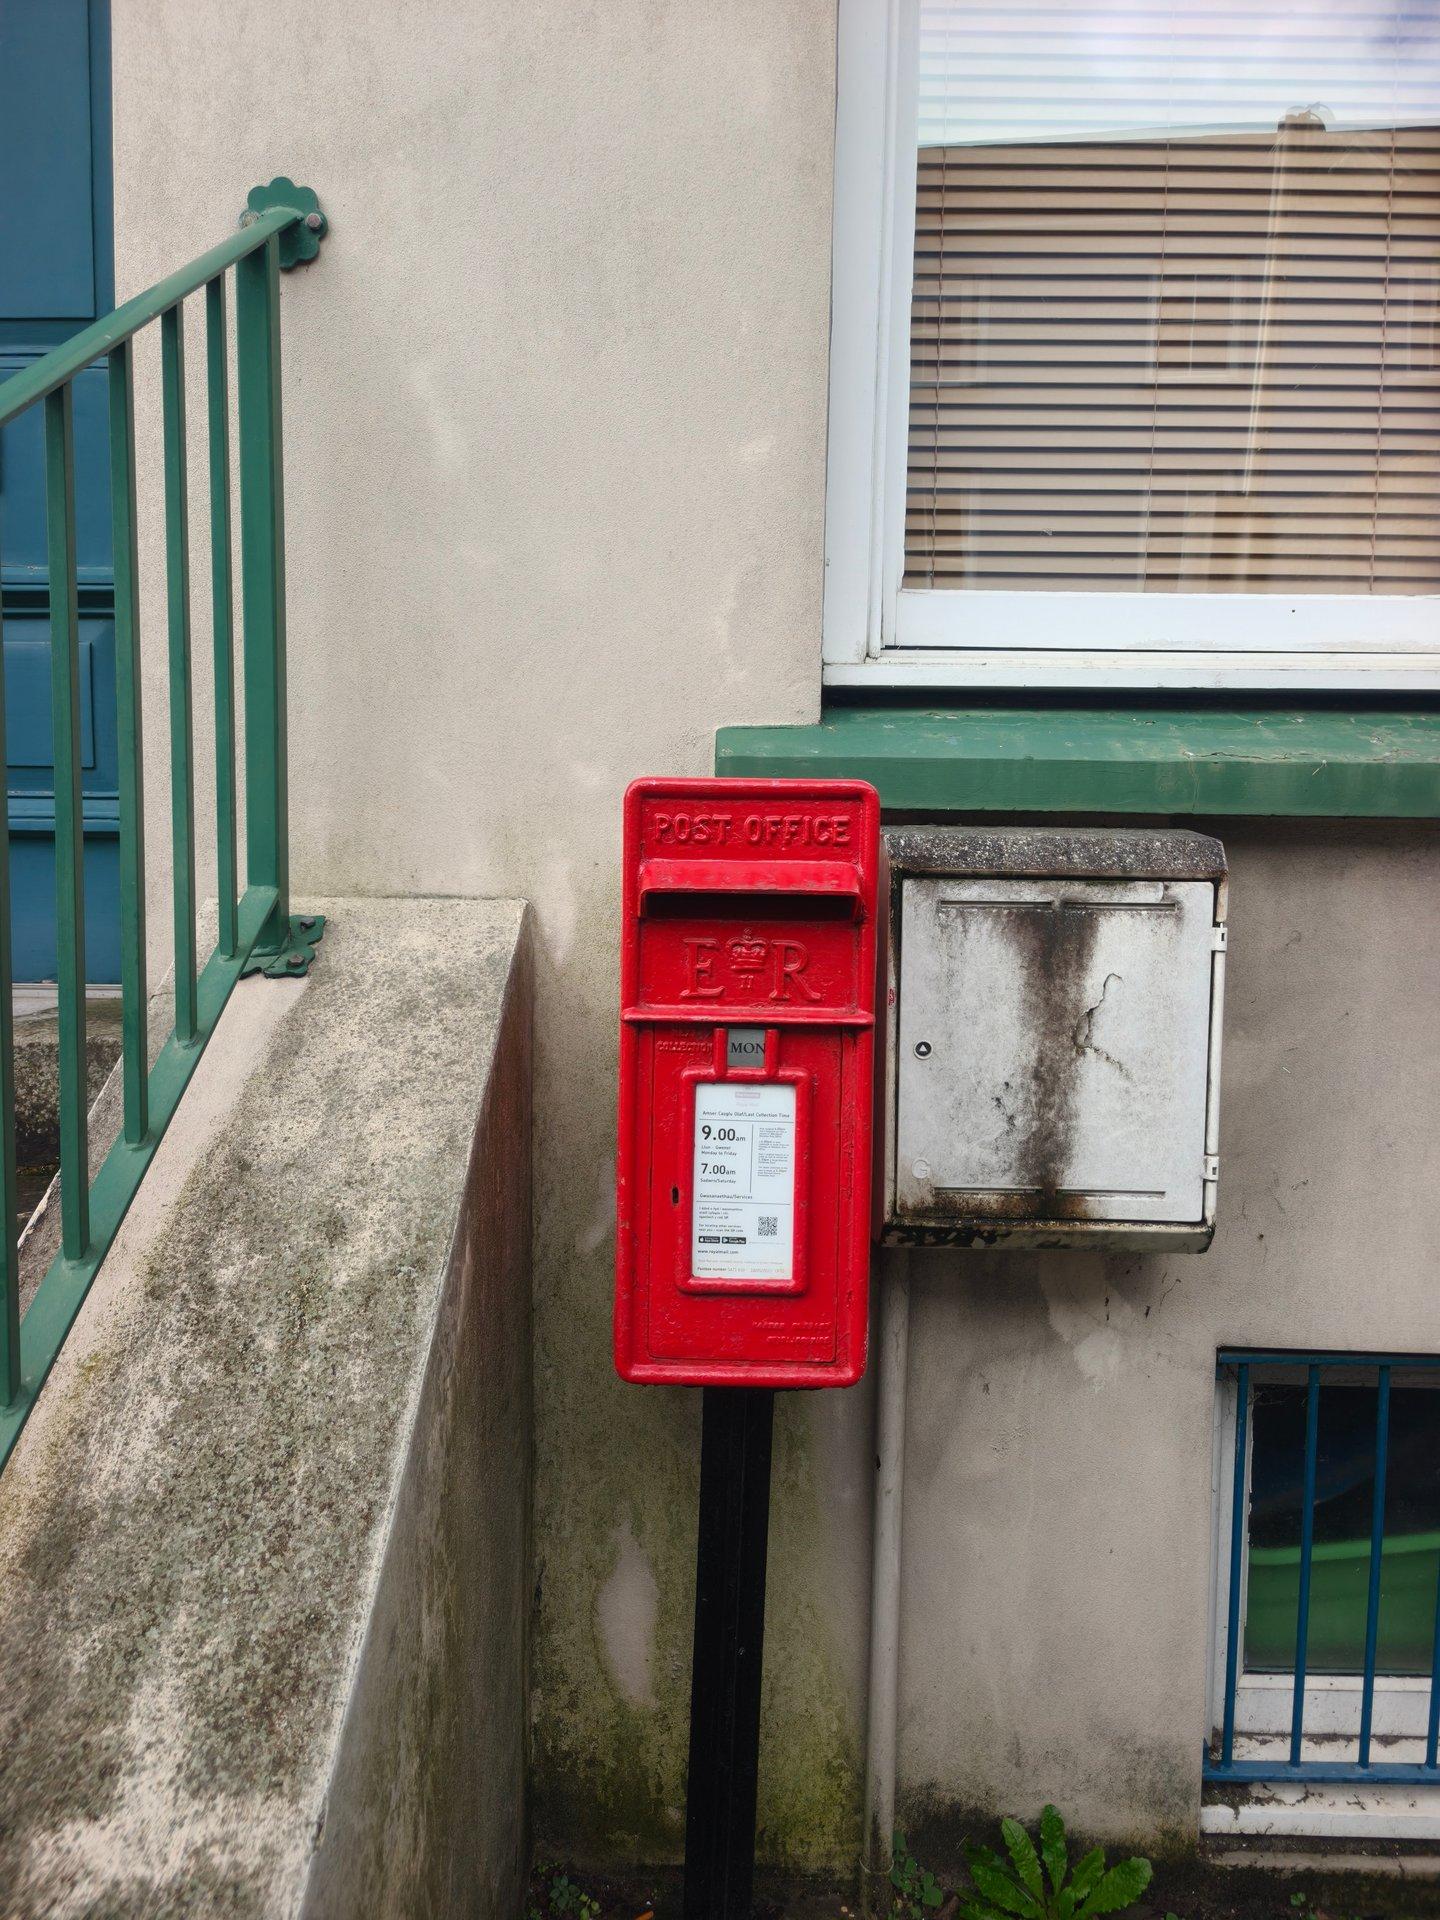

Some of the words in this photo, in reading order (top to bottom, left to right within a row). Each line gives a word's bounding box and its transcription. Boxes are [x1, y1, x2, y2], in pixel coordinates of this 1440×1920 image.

[654, 812, 732, 845] POST
[743, 814, 850, 846] OFFICE
[680, 937, 725, 998] E
[769, 939, 822, 1002] R
[730, 1042, 766, 1055] MON
[701, 1124, 746, 1142] 9.00am
[701, 1163, 737, 1175] 7.00am
